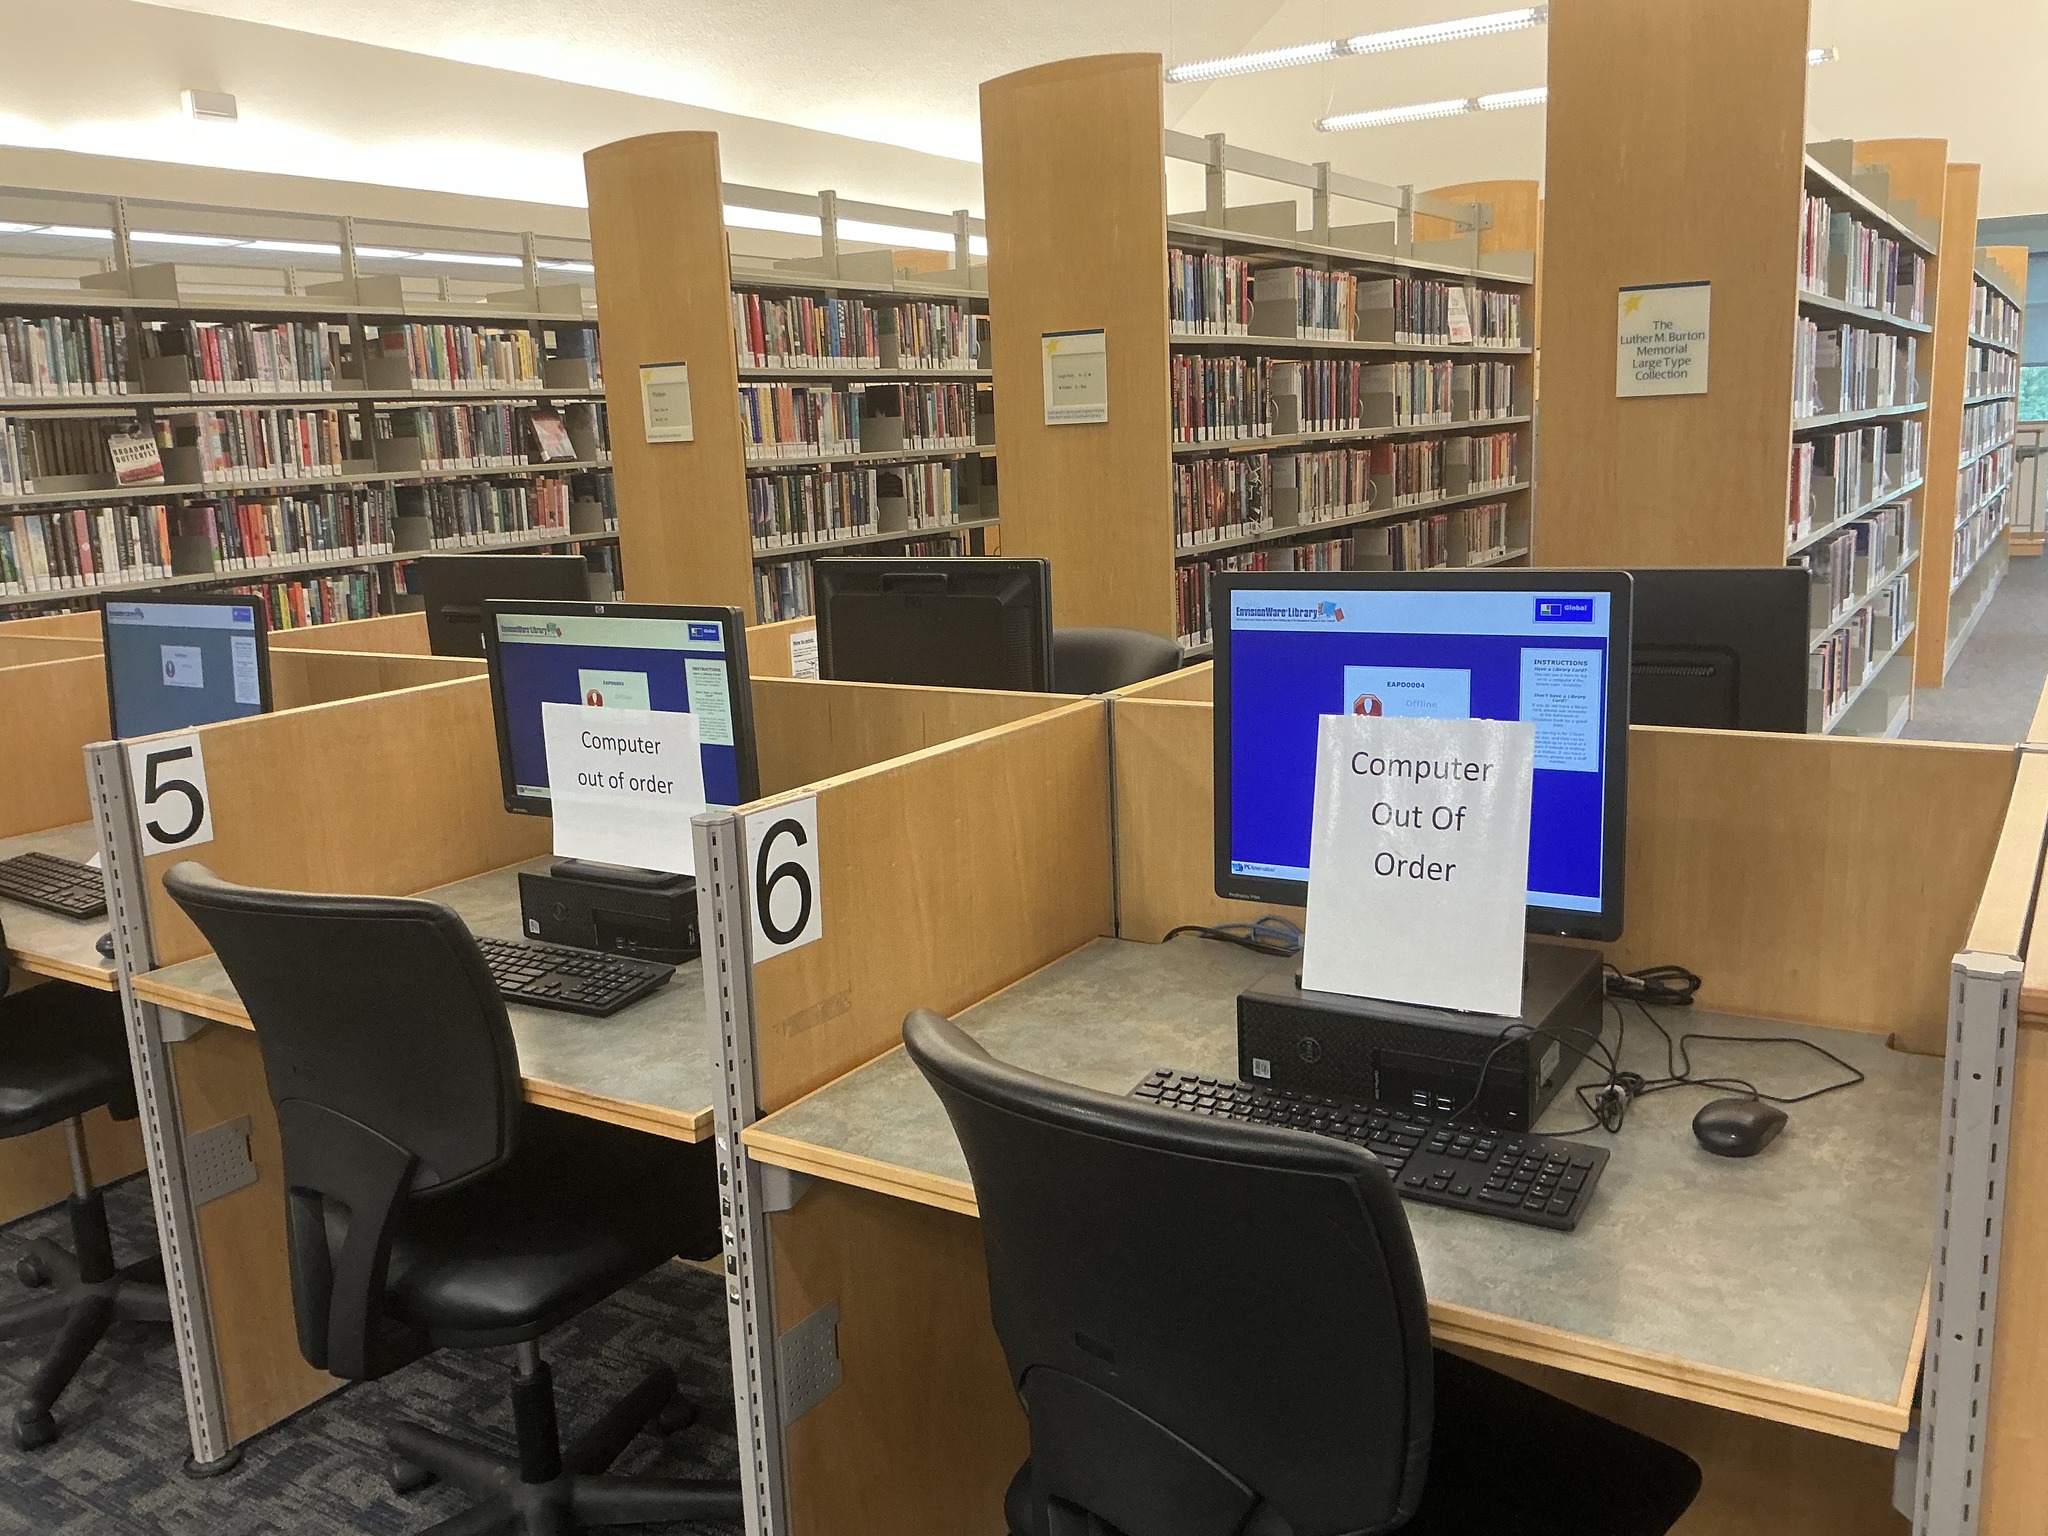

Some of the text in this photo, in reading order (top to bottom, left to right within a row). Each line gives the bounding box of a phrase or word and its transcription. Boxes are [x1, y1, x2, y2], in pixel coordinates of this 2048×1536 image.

[1653, 320, 1673, 330] The
[1620, 331, 1705, 345] Luther M. Burton
[1637, 344, 1688, 356] Memorial
[1633, 357, 1691, 370] Large Type
[1635, 369, 1688, 380] Collection
[112, 442, 154, 456] BROADWAY
[115, 450, 156, 463] BUTTERFLY
[1236, 606, 1318, 619] EnvisionWare Library
[1406, 700, 1437, 709] Offline
[581, 730, 661, 756] Computer
[1351, 750, 1494, 784] Computer
[578, 771, 674, 795] out of order
[143, 745, 205, 845] 5
[1371, 801, 1467, 832] Out Of
[1374, 851, 1457, 882] Order
[755, 818, 812, 946] 6
